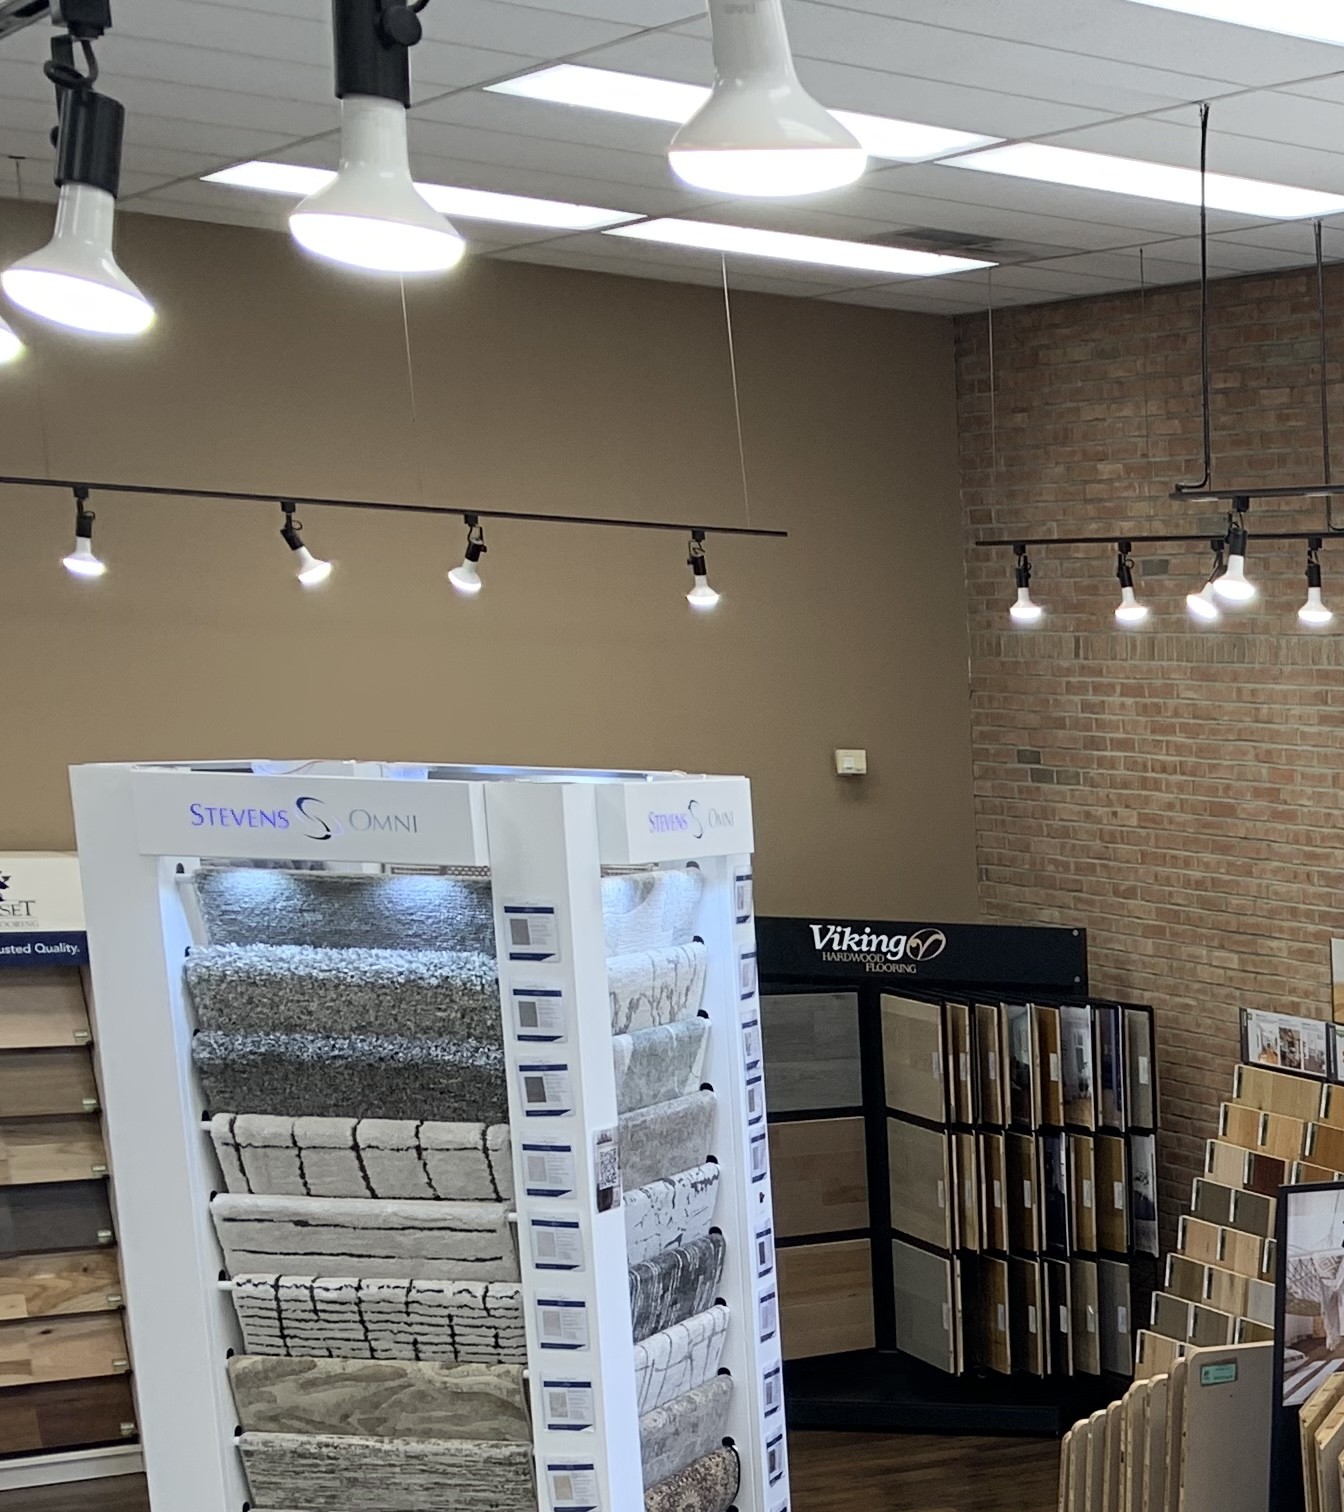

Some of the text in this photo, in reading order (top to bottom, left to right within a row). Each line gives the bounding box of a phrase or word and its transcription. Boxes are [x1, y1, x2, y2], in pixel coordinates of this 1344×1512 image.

[190, 803, 417, 833] STEVENS OMNI
[648, 811, 688, 833] STEVENS
[34, 942, 80, 956] Quality.
[809, 924, 907, 961] Viking
[822, 952, 885, 963] HARDWOOD
[865, 962, 917, 974] FLOORING
